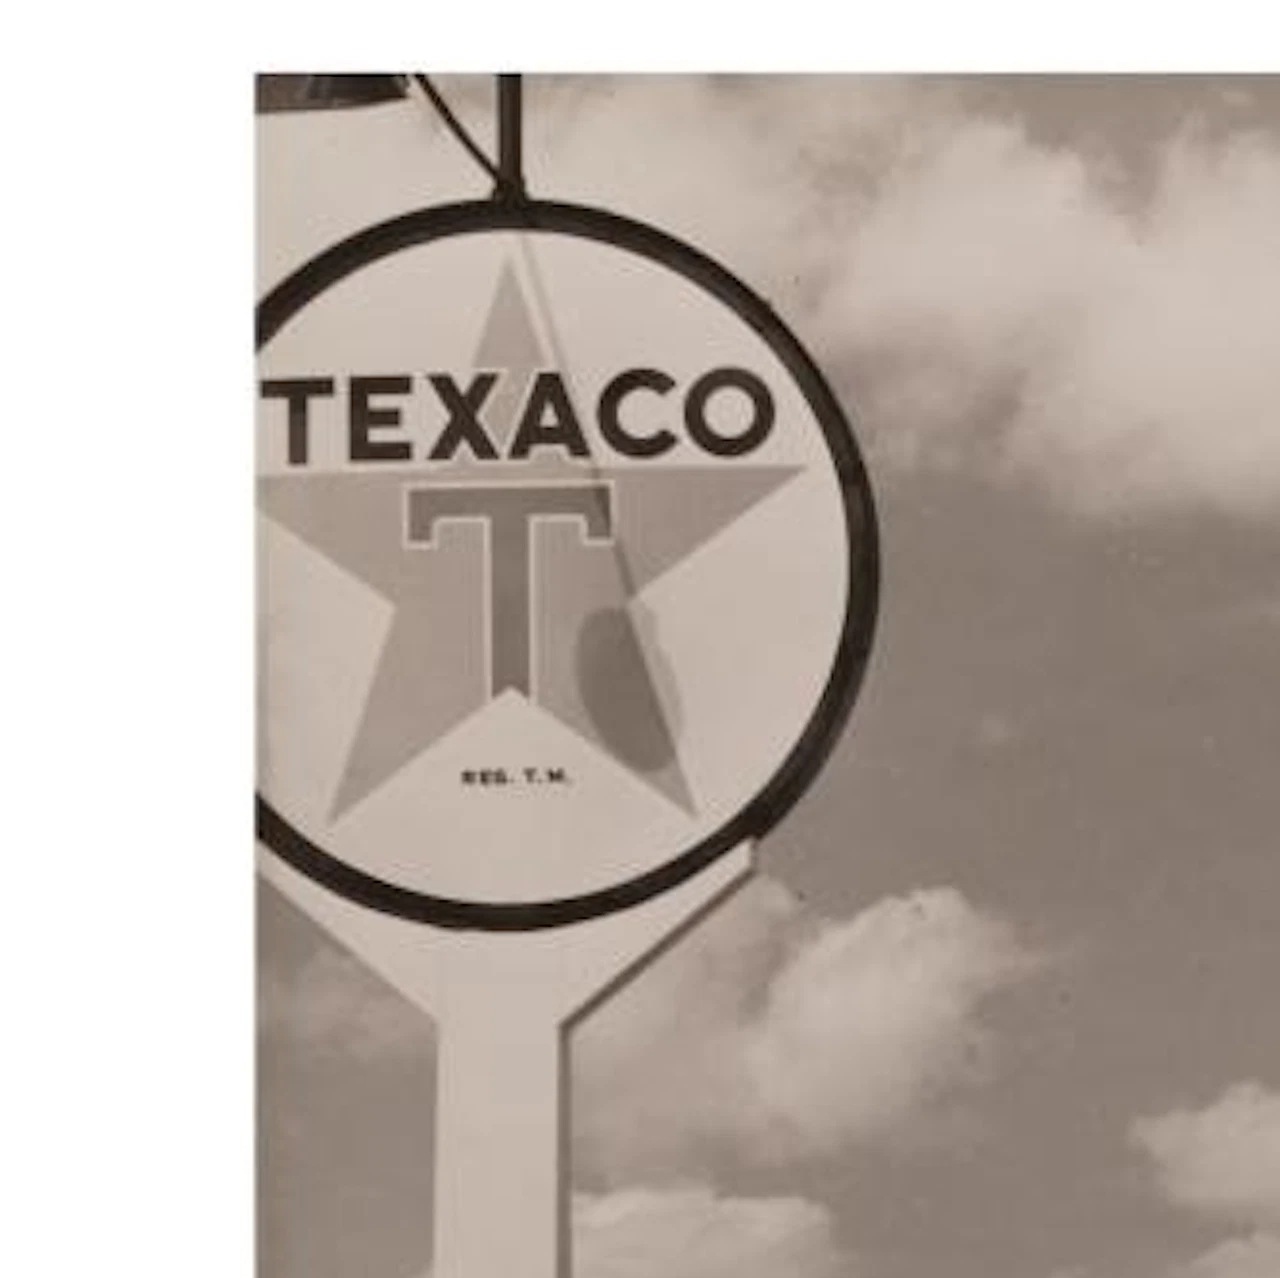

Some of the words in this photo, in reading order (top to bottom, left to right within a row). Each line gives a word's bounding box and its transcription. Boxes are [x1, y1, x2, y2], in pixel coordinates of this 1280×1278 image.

[261, 367, 776, 465] TEXACO
[405, 483, 614, 704] T
[461, 768, 514, 787] REG.
